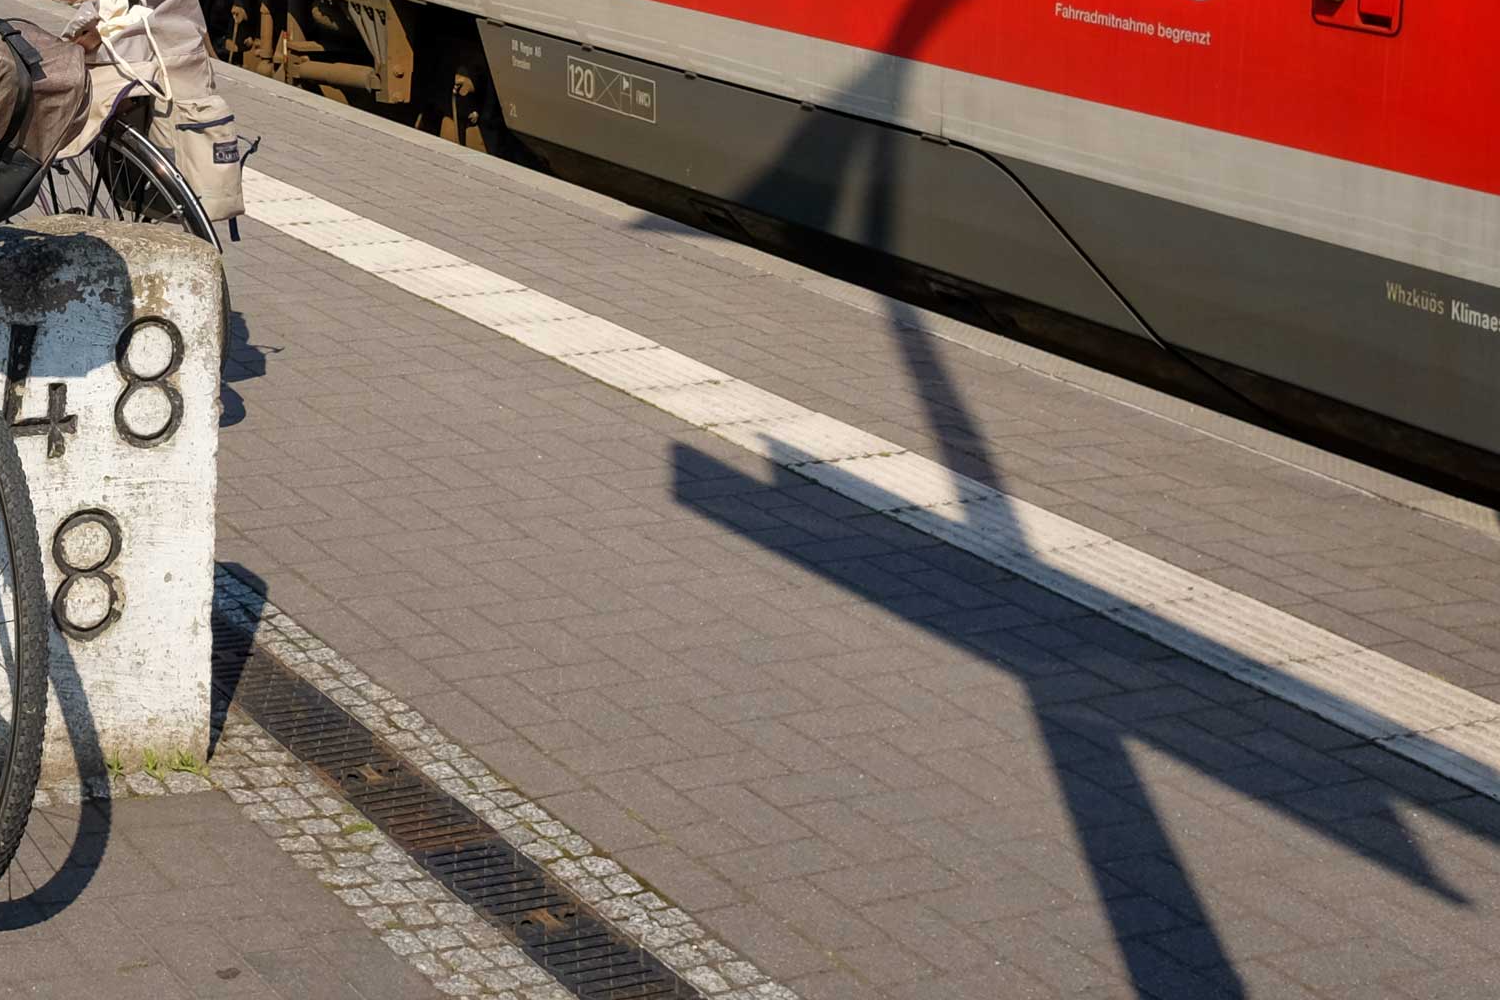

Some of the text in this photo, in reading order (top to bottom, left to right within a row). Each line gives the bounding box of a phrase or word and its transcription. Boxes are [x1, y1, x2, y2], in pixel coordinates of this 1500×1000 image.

[1055, 2, 1211, 46] Fahrradmitnahme begrenzt
[569, 63, 594, 99] 120
[52, 507, 126, 643] 8
